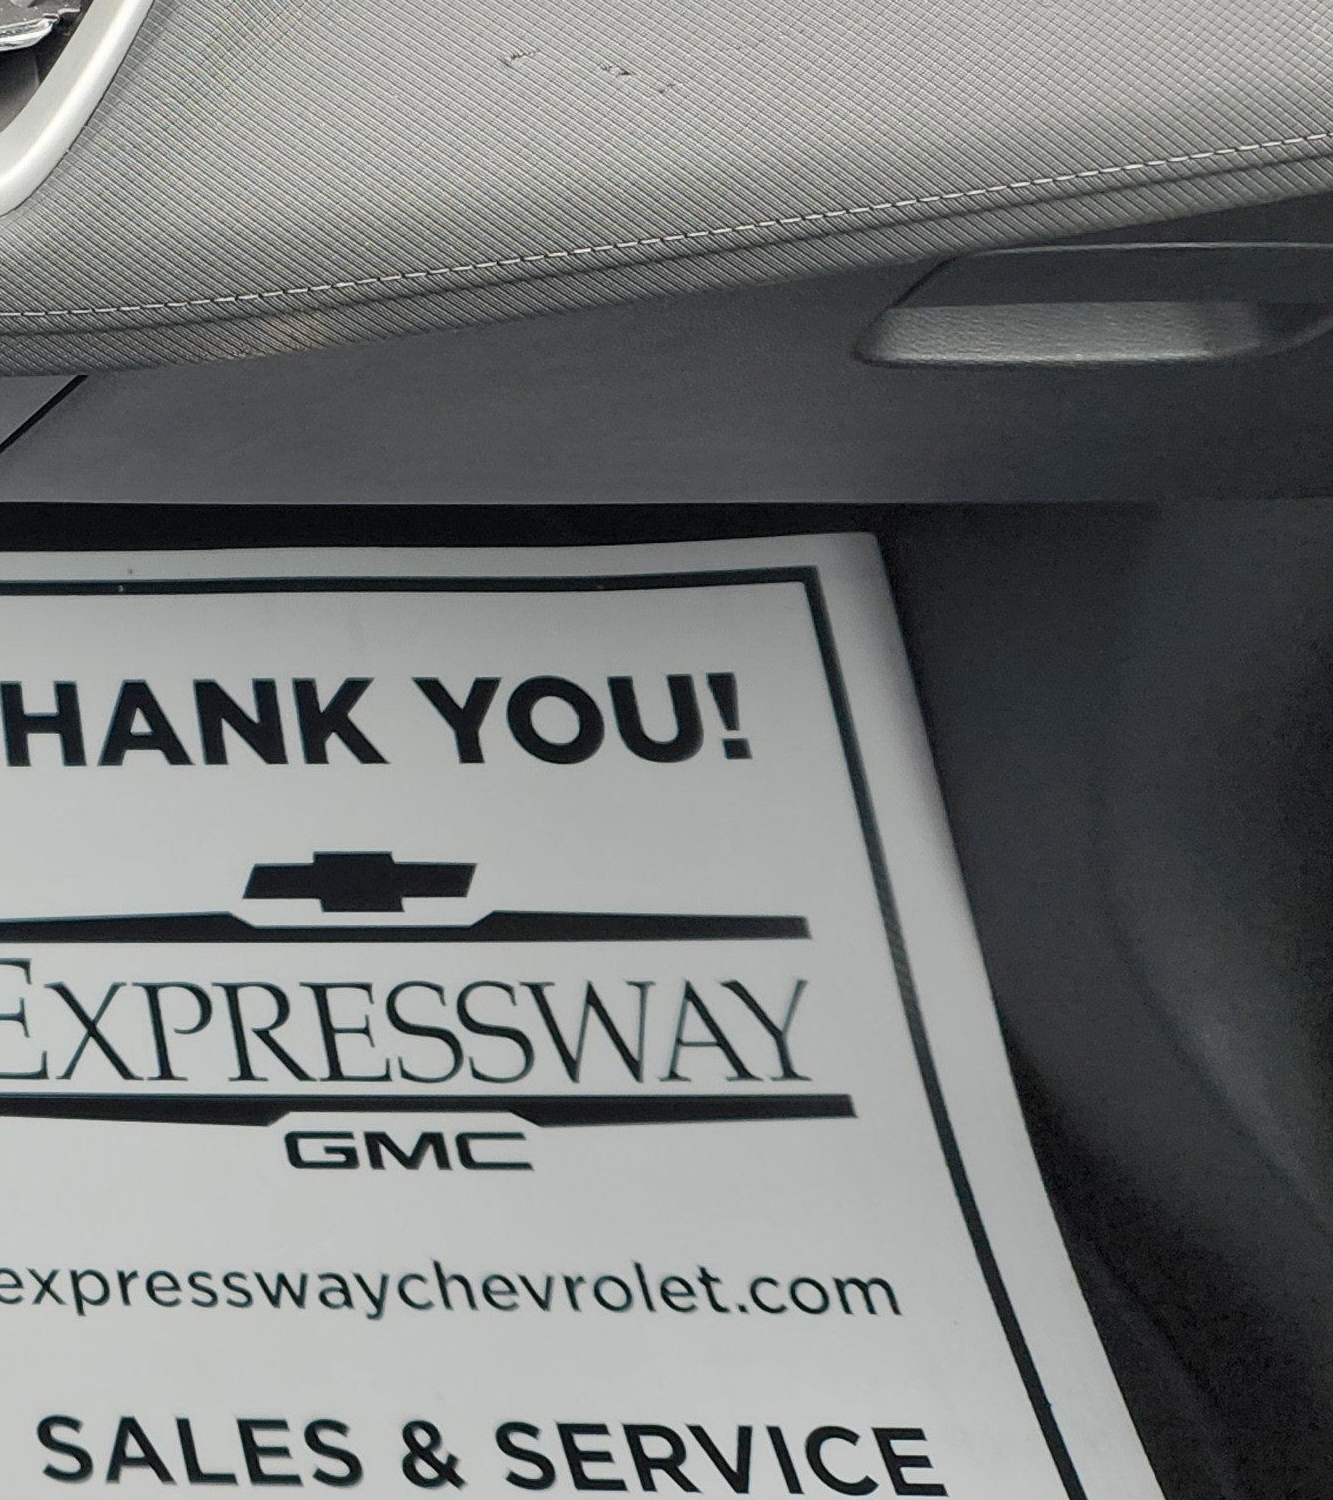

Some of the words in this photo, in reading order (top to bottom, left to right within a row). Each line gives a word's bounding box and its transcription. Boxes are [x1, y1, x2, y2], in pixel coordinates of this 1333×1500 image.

[412, 671, 753, 766] YOU!
[284, 1129, 534, 1171] GMC
[35, 1413, 364, 1488] SALES
[400, 1418, 466, 1490] &
[495, 1420, 949, 1497] SERVICE
